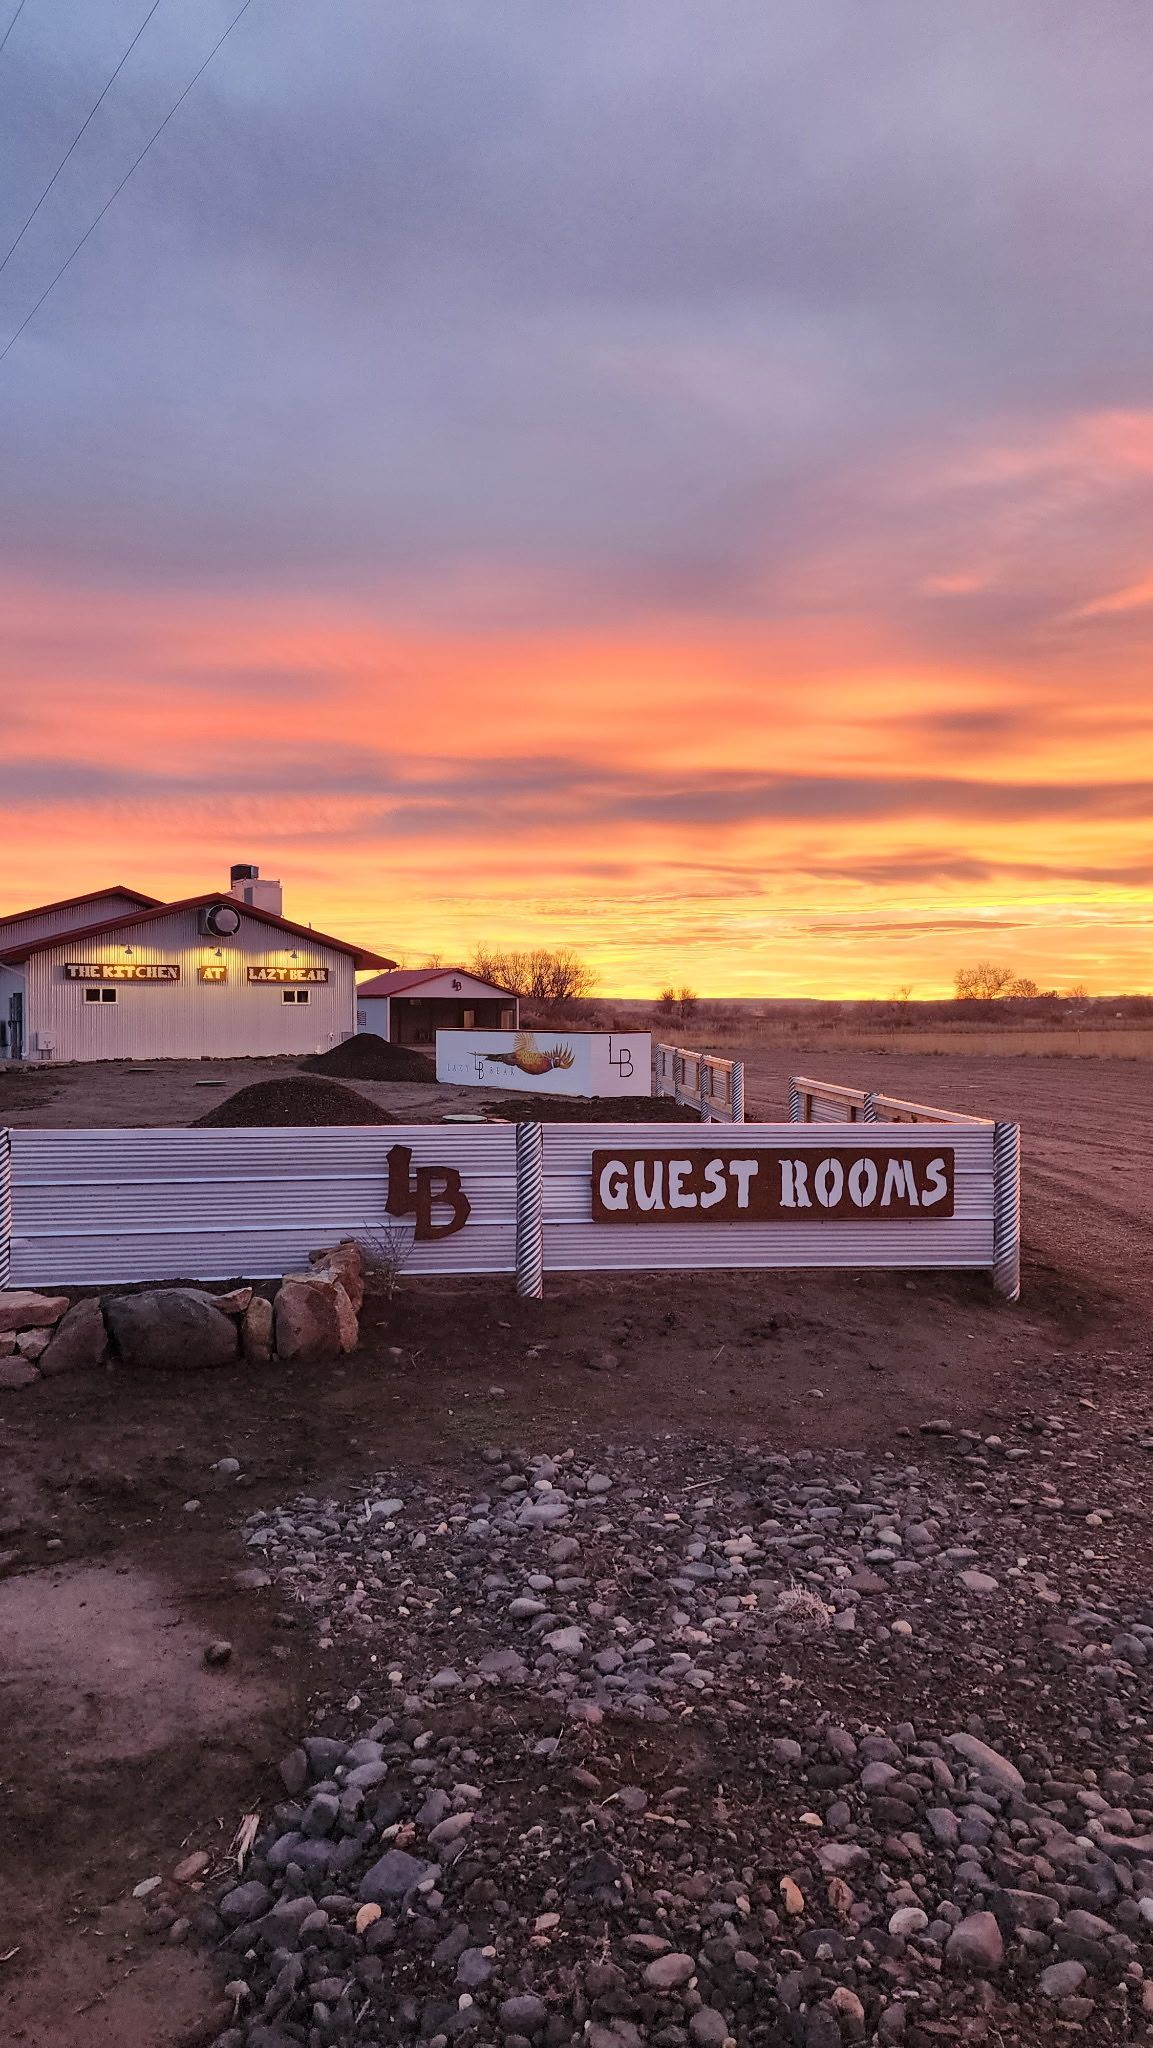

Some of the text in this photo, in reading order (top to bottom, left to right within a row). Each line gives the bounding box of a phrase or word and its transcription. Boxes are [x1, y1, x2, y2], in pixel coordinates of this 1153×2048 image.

[67, 965, 178, 979] THE KITCHEN
[202, 967, 225, 980] AT
[248, 967, 326, 982] LAZY BEAR
[447, 1063, 470, 1073] LAZY
[600, 1157, 949, 1211] GUEST ROOMS
[384, 1144, 472, 1241] LB
